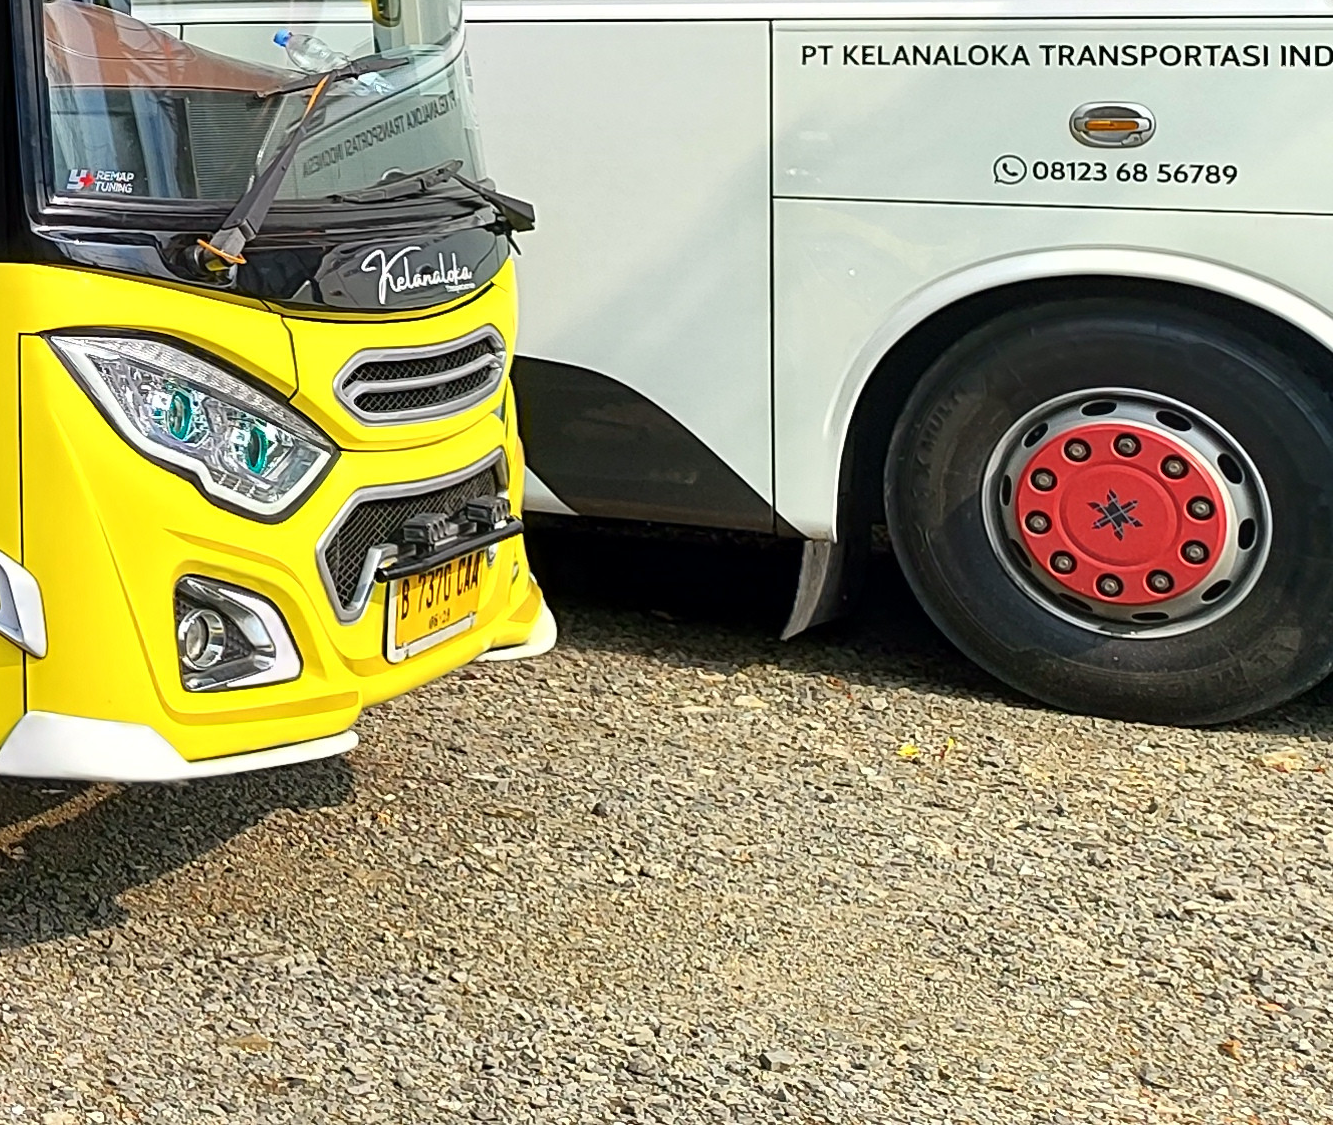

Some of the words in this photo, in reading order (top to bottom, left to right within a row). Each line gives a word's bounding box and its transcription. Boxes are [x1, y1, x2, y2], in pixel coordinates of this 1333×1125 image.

[802, 45, 834, 67] PT
[843, 44, 1031, 67] KELANALOKA
[1039, 44, 1269, 67] TRANSPORTASI
[96, 170, 135, 183] REMAP
[1033, 161, 1108, 182] 08123
[1116, 161, 1148, 183] 68
[1156, 163, 1238, 185] 56789
[95, 181, 133, 194] TUNING
[361, 246, 473, 305] Kelanaloka
[401, 579, 410, 620] B
